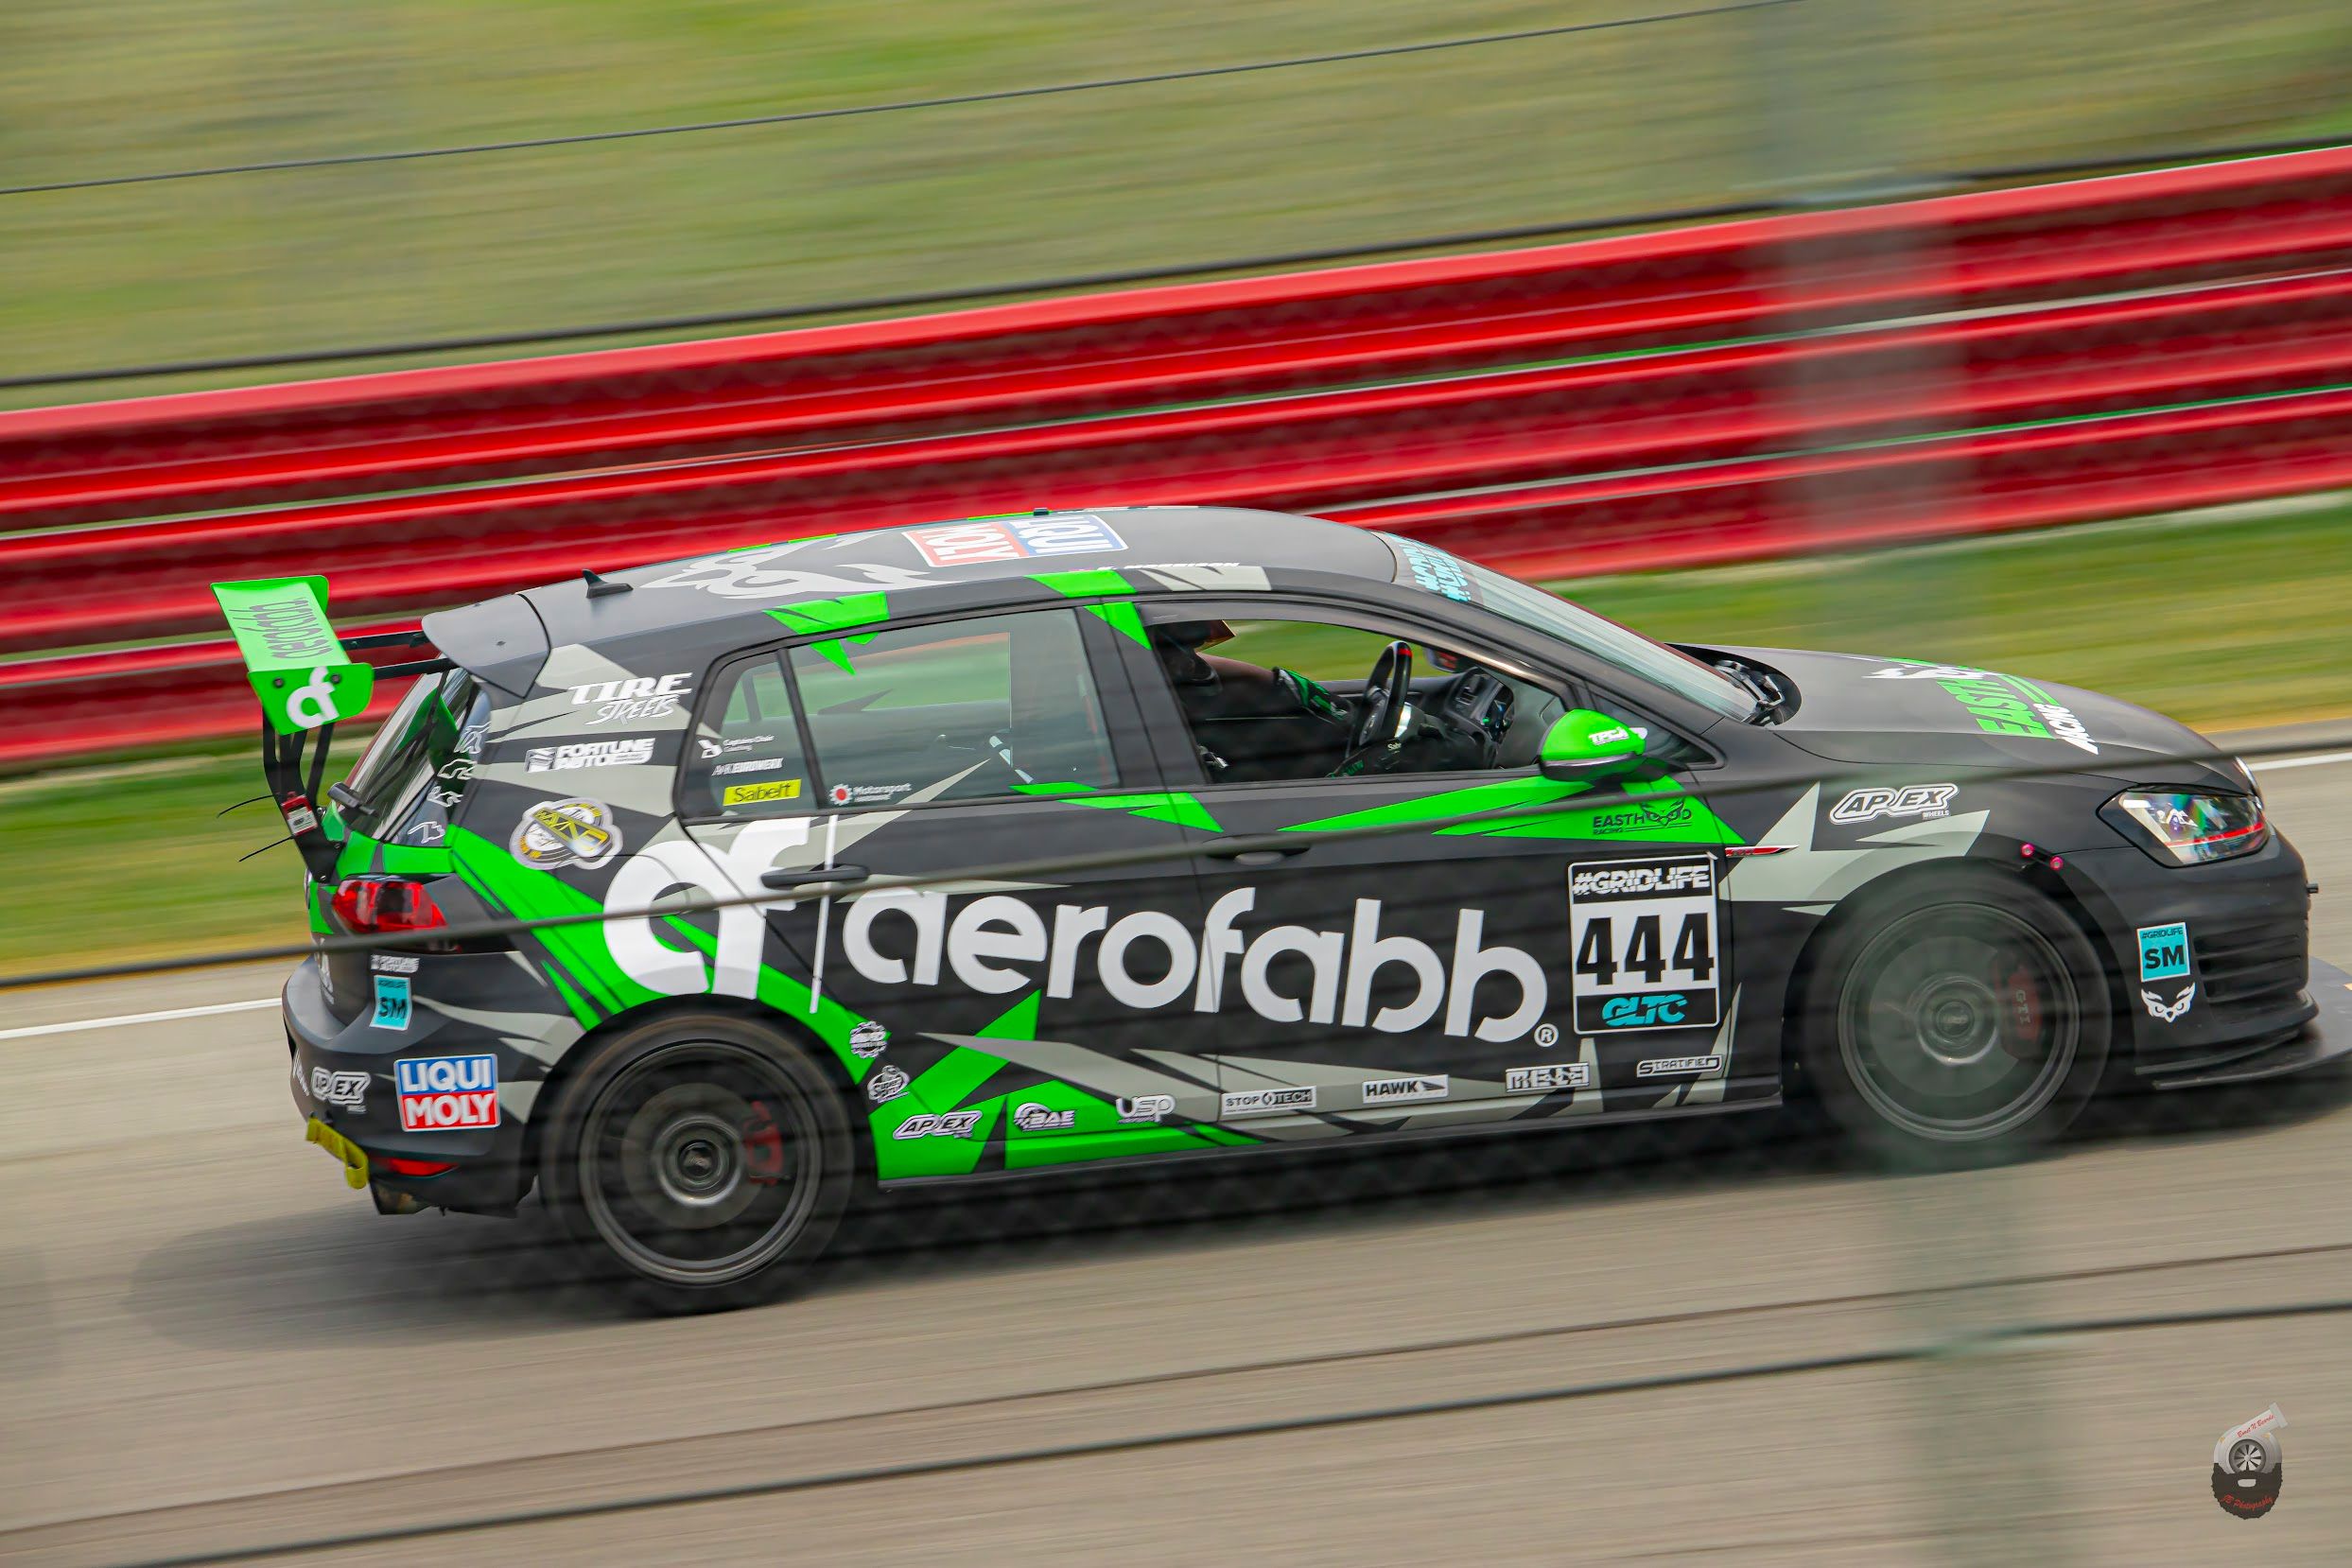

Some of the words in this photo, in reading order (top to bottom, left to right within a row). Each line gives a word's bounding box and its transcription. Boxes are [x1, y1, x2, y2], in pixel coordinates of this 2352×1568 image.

[568, 672, 693, 705] TIRE
[555, 738, 656, 758] FORTUNE
[554, 756, 607, 771] AUTO
[733, 783, 792, 803] Sabelt
[1836, 787, 1952, 819] APEX
[1922, 810, 1949, 820] WHEELS
[1573, 864, 1711, 896] #GRIDLIFE
[1576, 913, 1715, 985] 444
[2144, 944, 2186, 969] SM
[843, 886, 1548, 1042] aerofabb
[379, 996, 408, 1019] SM
[1601, 993, 1688, 1027] GLTC
[400, 1058, 493, 1093] LIQUI
[1639, 1056, 1720, 1075] STRATIFIED
[1366, 1080, 1419, 1097] HAWK
[404, 1093, 497, 1127] MOLY
[1116, 1093, 1176, 1123] USP
[897, 1114, 978, 1136] APEX
